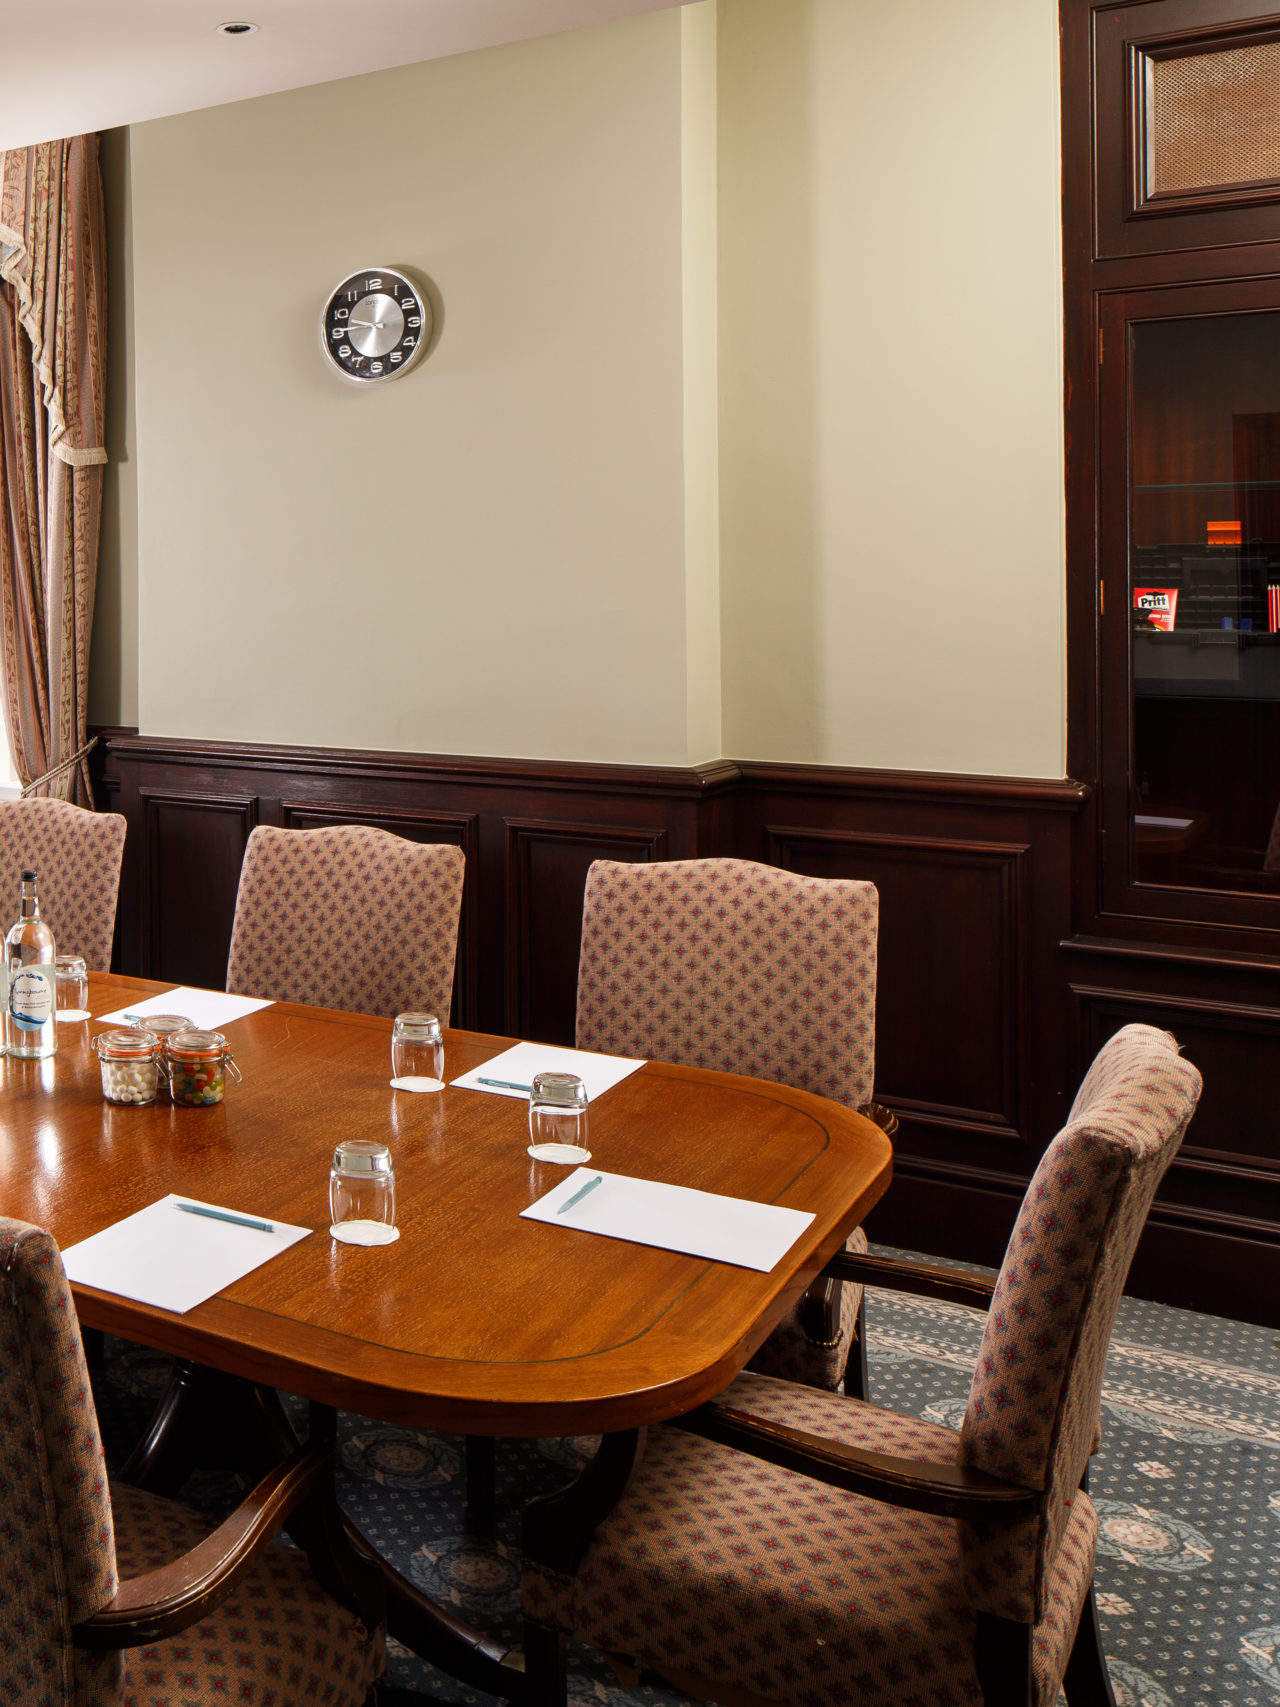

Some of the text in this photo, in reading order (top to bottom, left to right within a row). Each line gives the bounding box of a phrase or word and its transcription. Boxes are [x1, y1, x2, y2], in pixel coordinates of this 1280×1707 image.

[365, 278, 383, 291] 12
[394, 284, 398, 296] 1
[347, 290, 358, 302] 11
[401, 297, 415, 310] 2
[334, 308, 349, 321] 10
[407, 316, 421, 328] 3
[332, 327, 345, 339] 9
[403, 336, 417, 347] 4
[338, 345, 352, 358] 8
[390, 351, 402, 363] 5
[352, 354, 364, 368] 7
[370, 361, 383, 373] 6
[1140, 595, 1166, 608] Pritt
